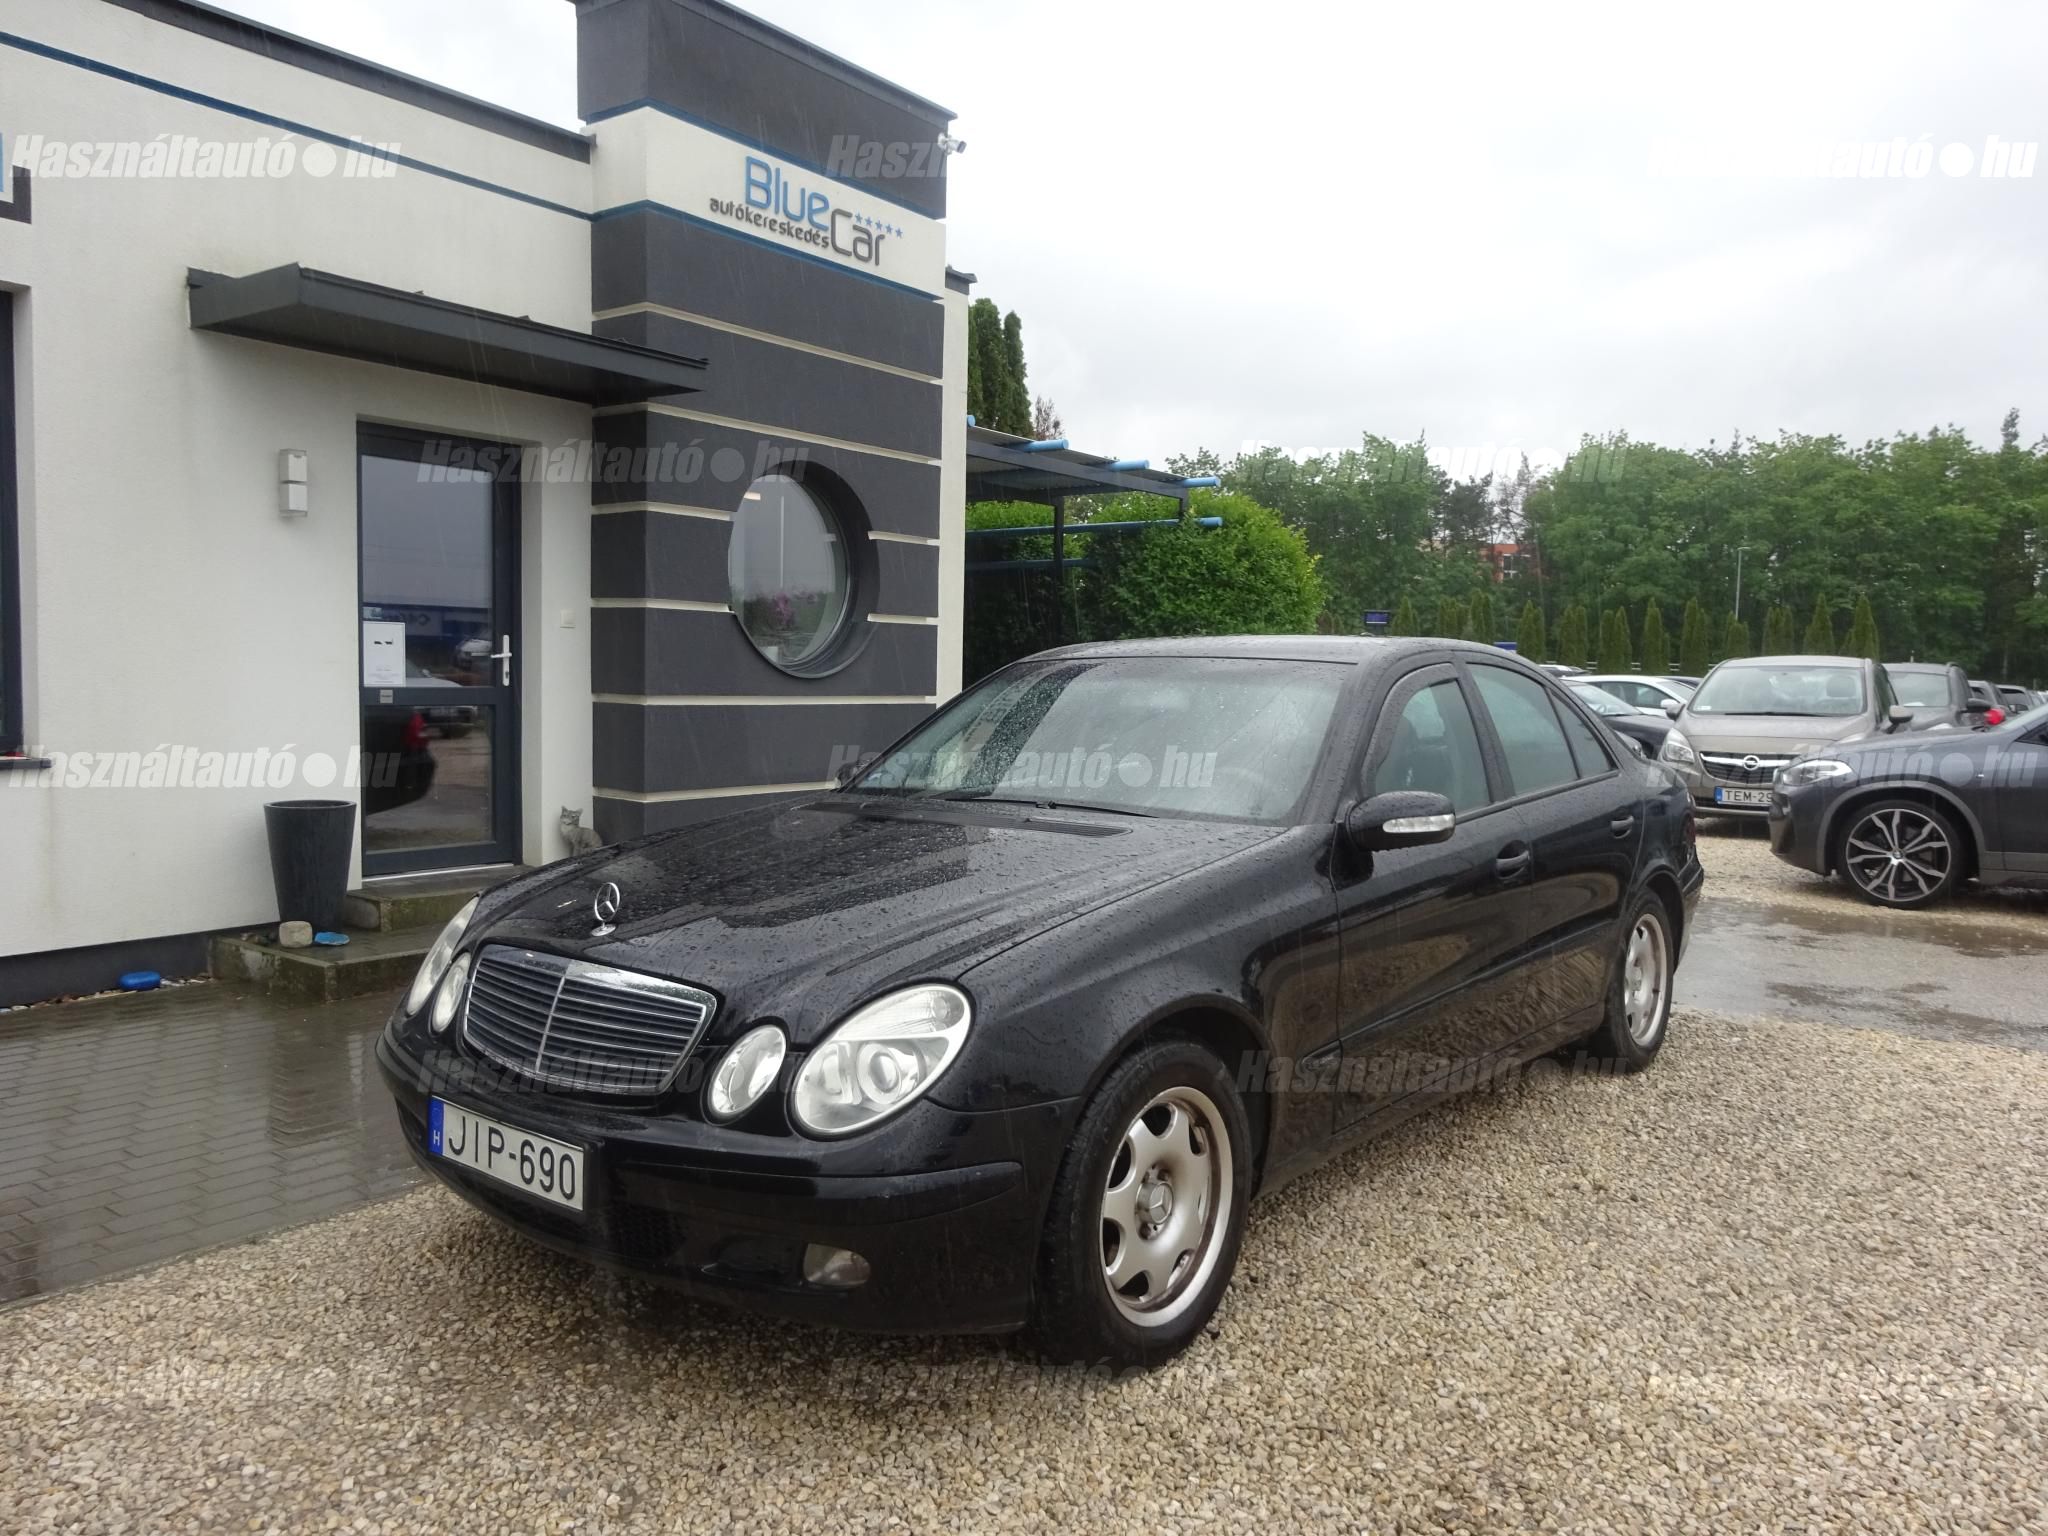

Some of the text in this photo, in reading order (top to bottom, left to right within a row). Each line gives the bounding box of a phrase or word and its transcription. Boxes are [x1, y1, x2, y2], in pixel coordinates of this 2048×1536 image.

[710, 198, 830, 249] autókereskedés
[1725, 790, 1773, 803] TEM-29
[433, 1115, 576, 1201] H JIP-690
